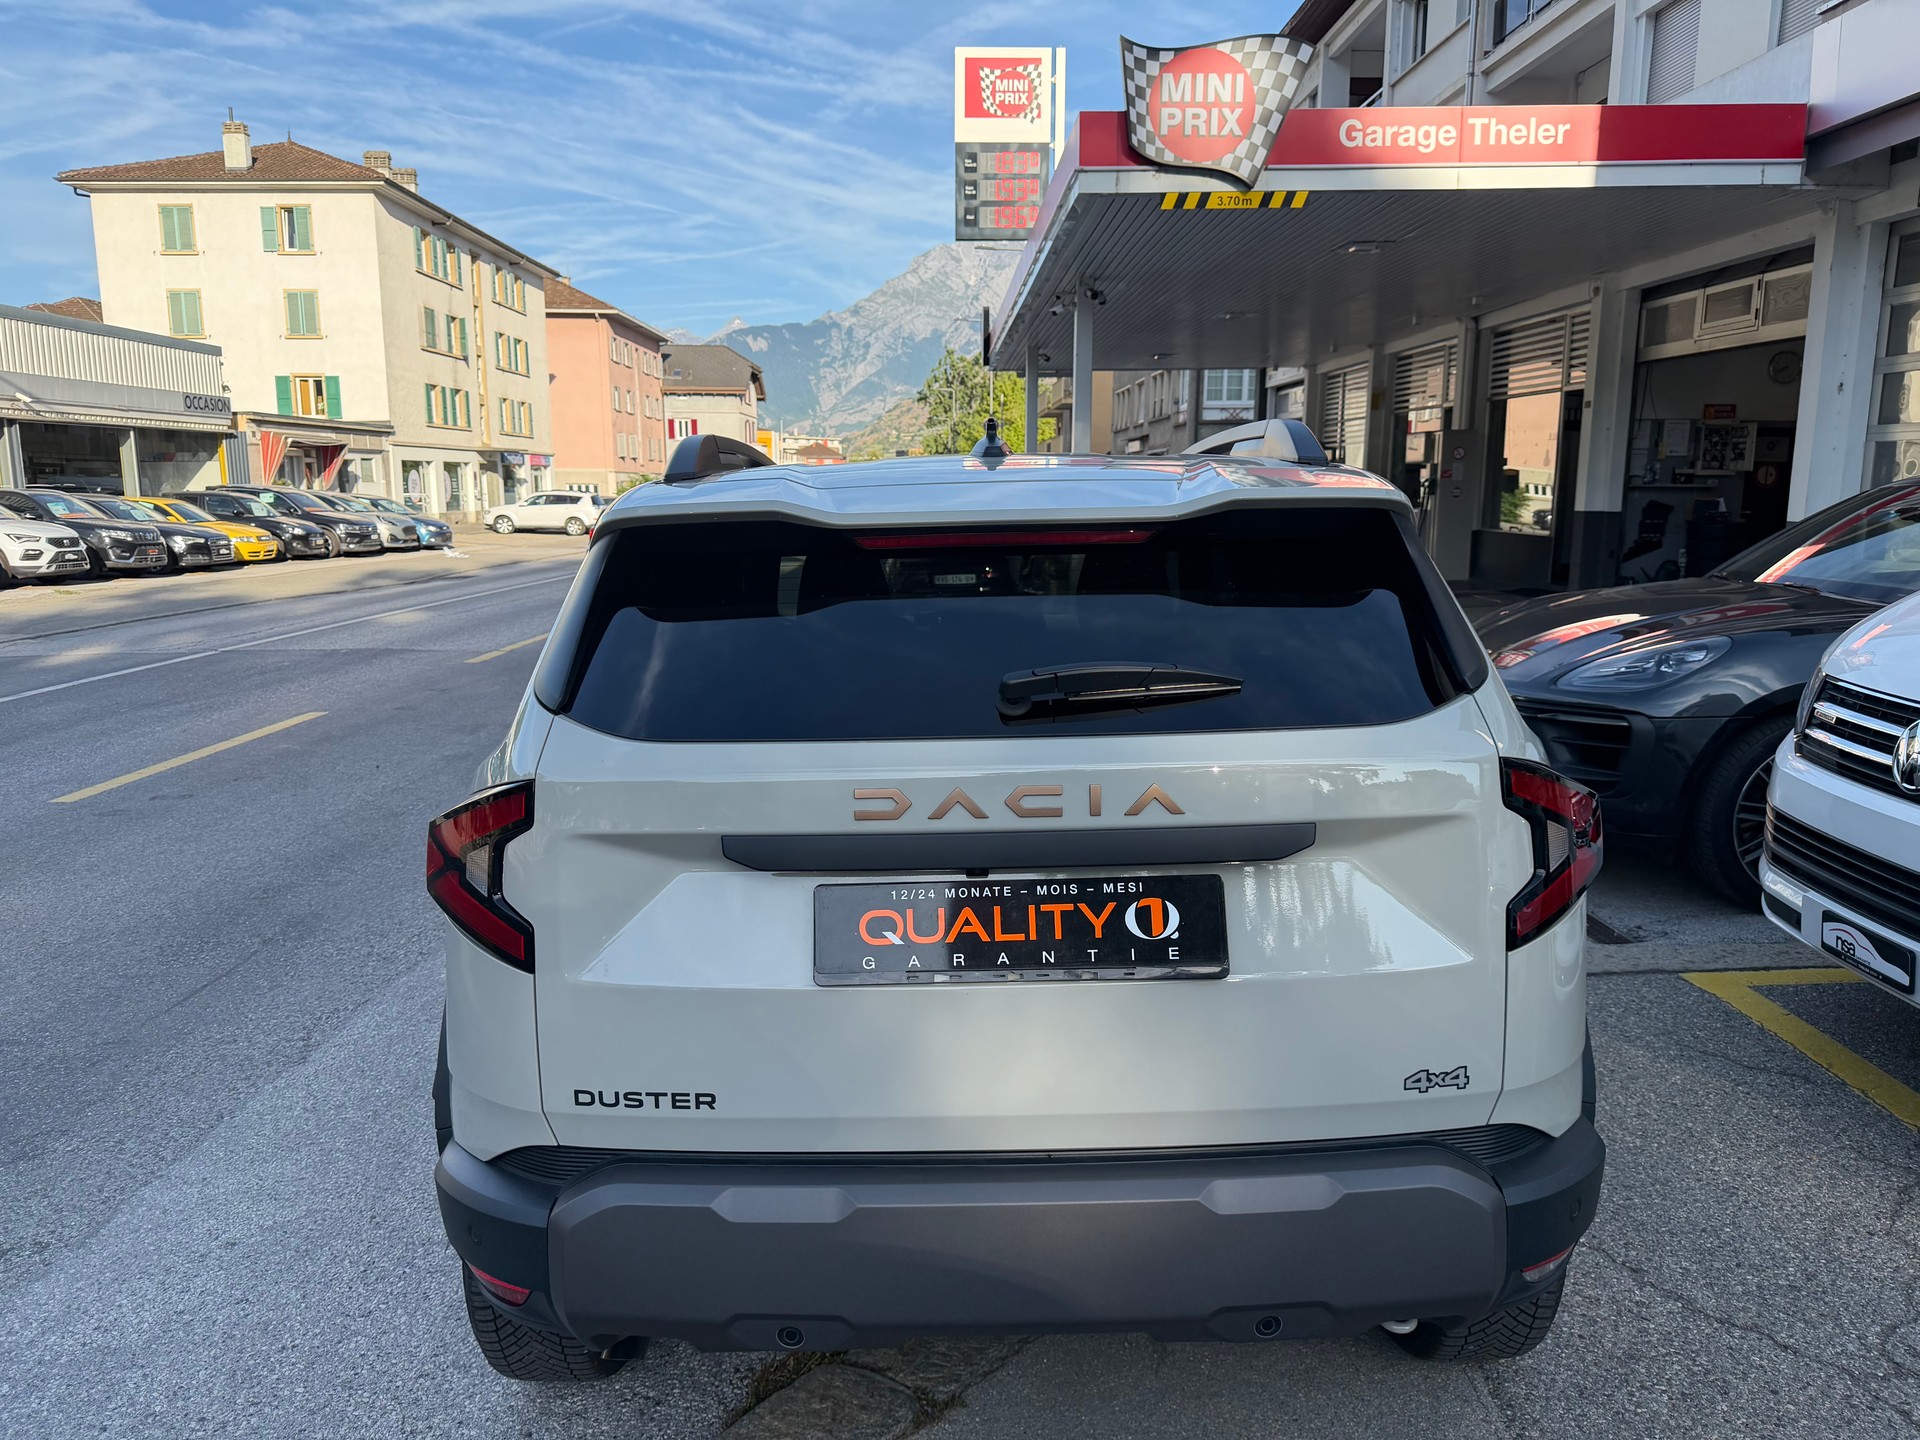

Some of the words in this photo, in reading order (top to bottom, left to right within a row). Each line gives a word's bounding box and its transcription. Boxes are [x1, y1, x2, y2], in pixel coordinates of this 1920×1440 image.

[995, 79, 1029, 91] MINI
[1160, 72, 1245, 104] MINI
[995, 92, 1029, 105] PRIX
[1160, 107, 1244, 137] PRIX
[1339, 119, 1457, 153] Garage
[1467, 117, 1570, 145] Theler
[184, 395, 231, 413] OCCASION
[854, 783, 1186, 821] DACIA
[891, 888, 936, 900] 12/24
[944, 886, 1012, 899] MONATE
[1036, 884, 1078, 896] MOIS
[1103, 882, 1143, 893] MESI
[858, 902, 1118, 946] QUALITY
[1836, 934, 1856, 957] nsa
[862, 947, 1180, 970] GARANTIE
[1404, 1065, 1470, 1093] 4x4
[573, 1089, 717, 1110] DUSTER
